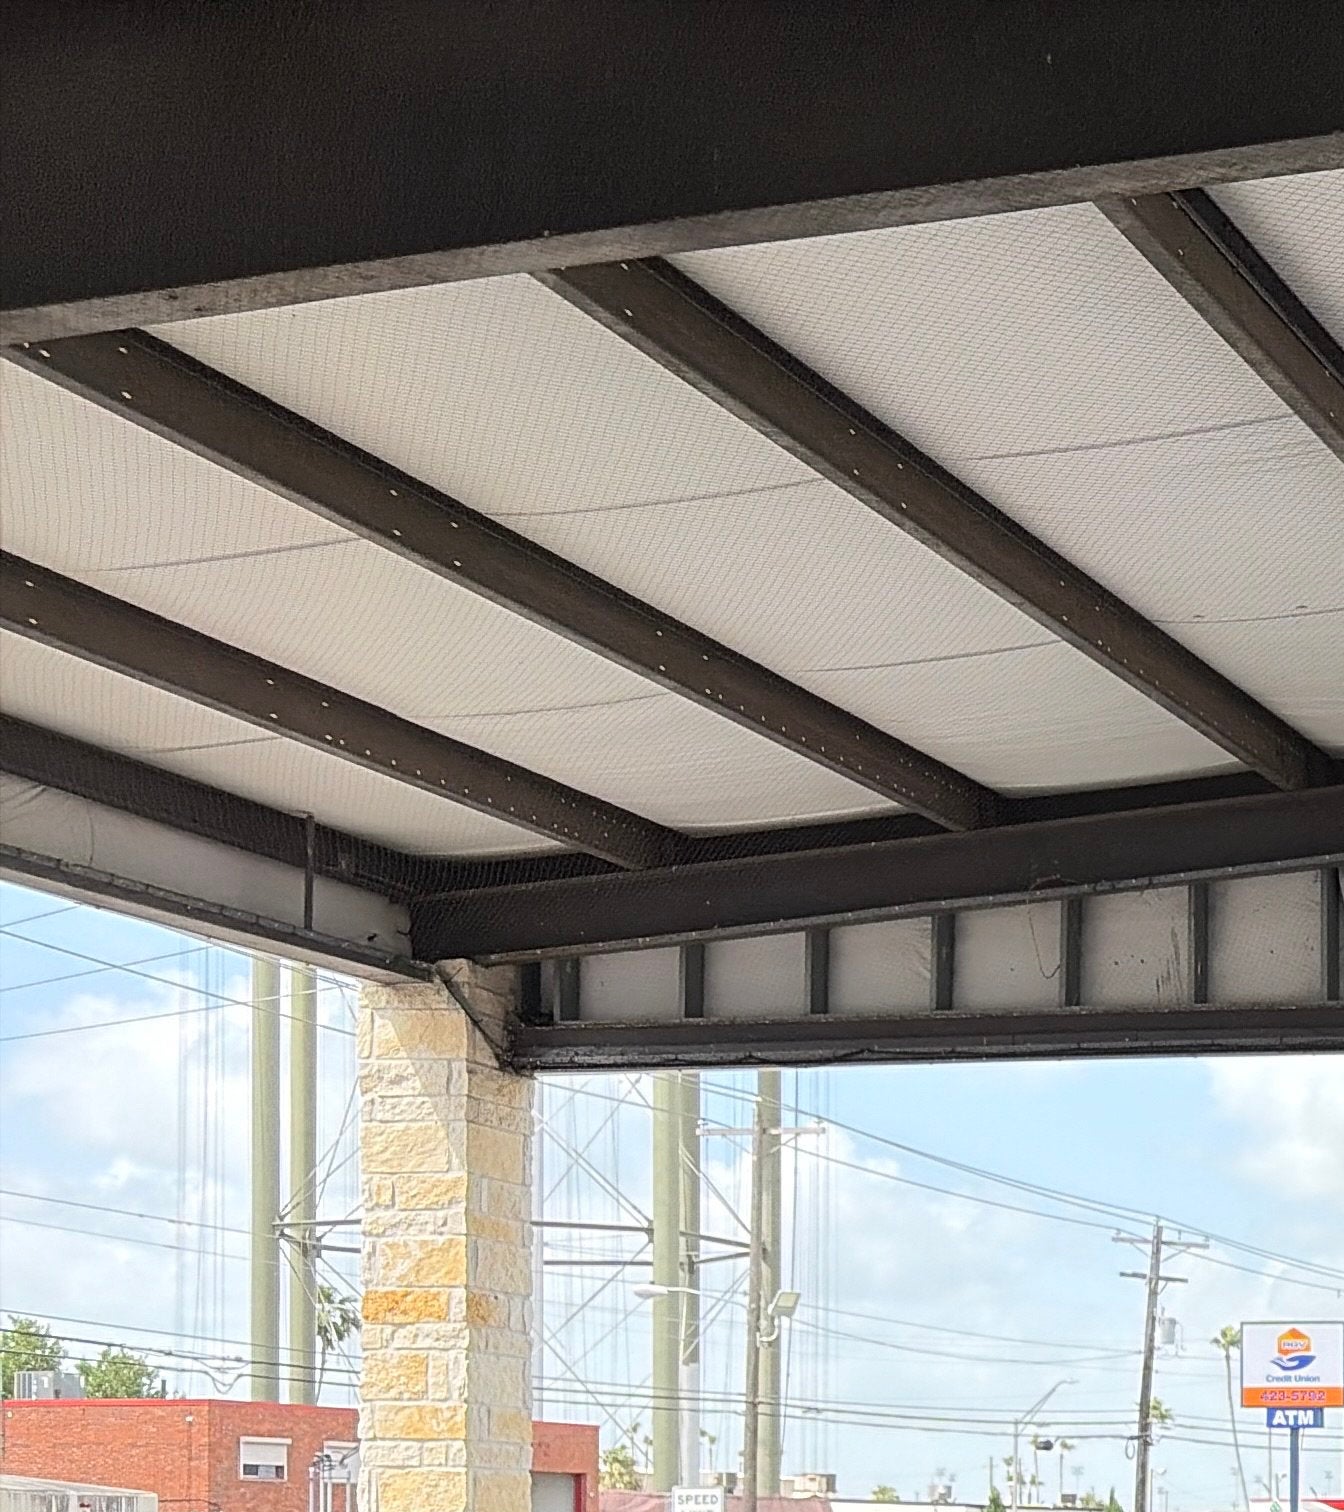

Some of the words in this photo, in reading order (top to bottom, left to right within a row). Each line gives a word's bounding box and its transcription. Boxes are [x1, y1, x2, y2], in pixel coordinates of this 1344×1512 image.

[1265, 1374, 1292, 1383] Credit
[1294, 1374, 1321, 1383] Union
[1272, 1410, 1314, 1426] ATM
[677, 1494, 719, 1505] SPEED
